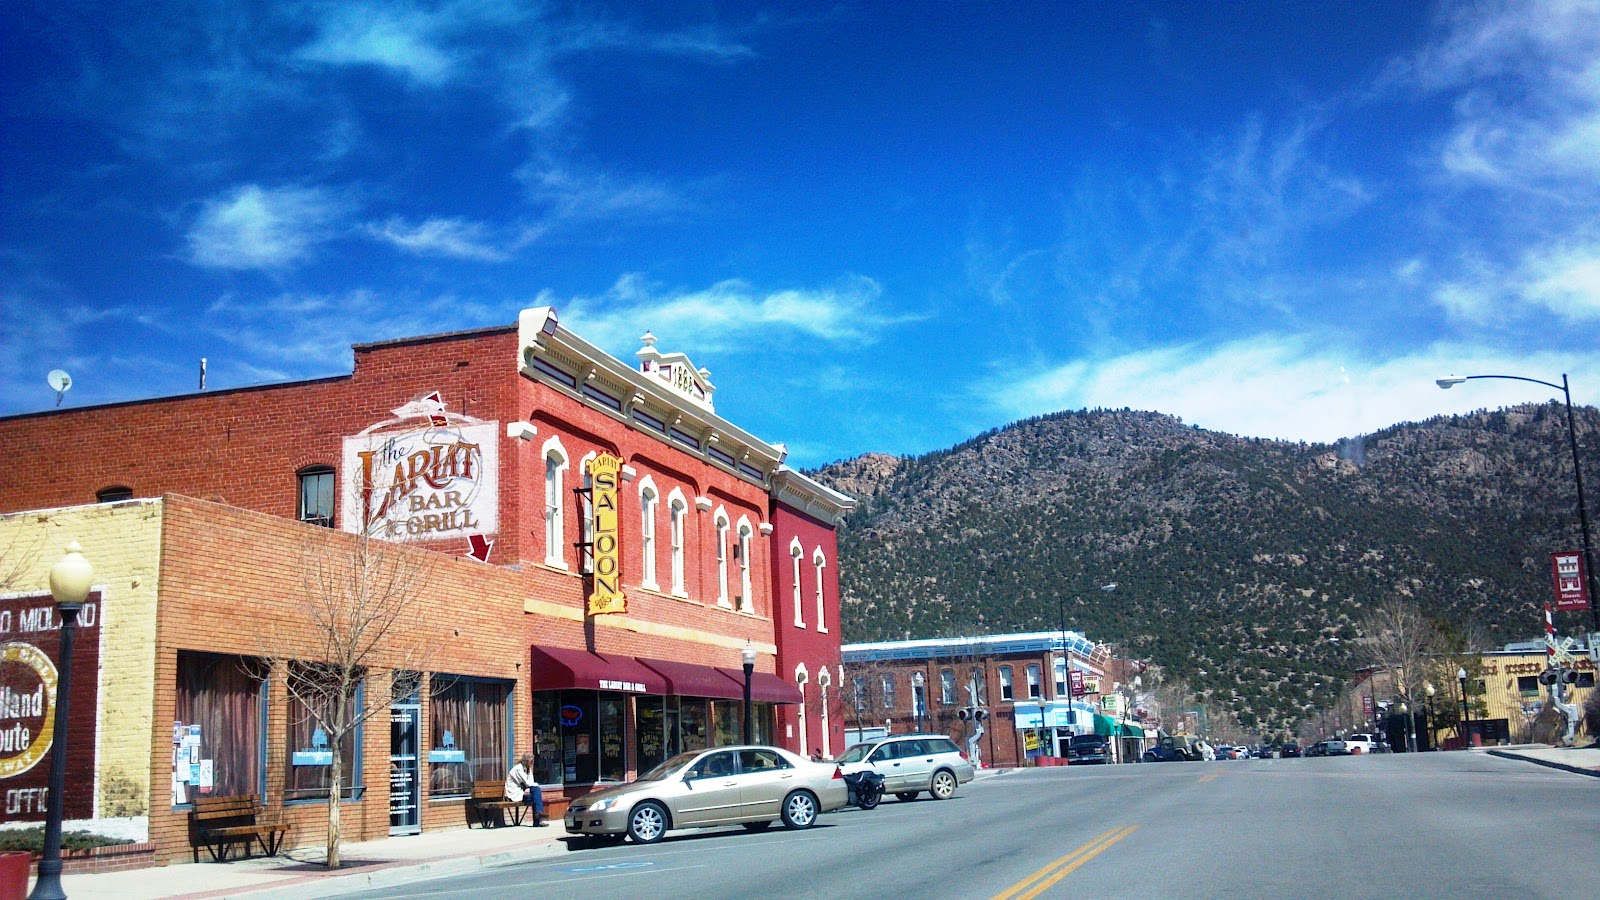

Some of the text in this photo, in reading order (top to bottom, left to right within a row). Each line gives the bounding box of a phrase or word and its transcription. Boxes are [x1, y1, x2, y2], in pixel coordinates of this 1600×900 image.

[382, 437, 414, 464] the
[593, 456, 617, 472] LARIAT
[357, 441, 480, 531] LARIAT
[408, 490, 467, 512] BAR
[406, 509, 479, 535] GRILL
[594, 472, 617, 596] SALOON
[20, 603, 97, 633] MIDLND
[6, 787, 49, 814] OFFIC
